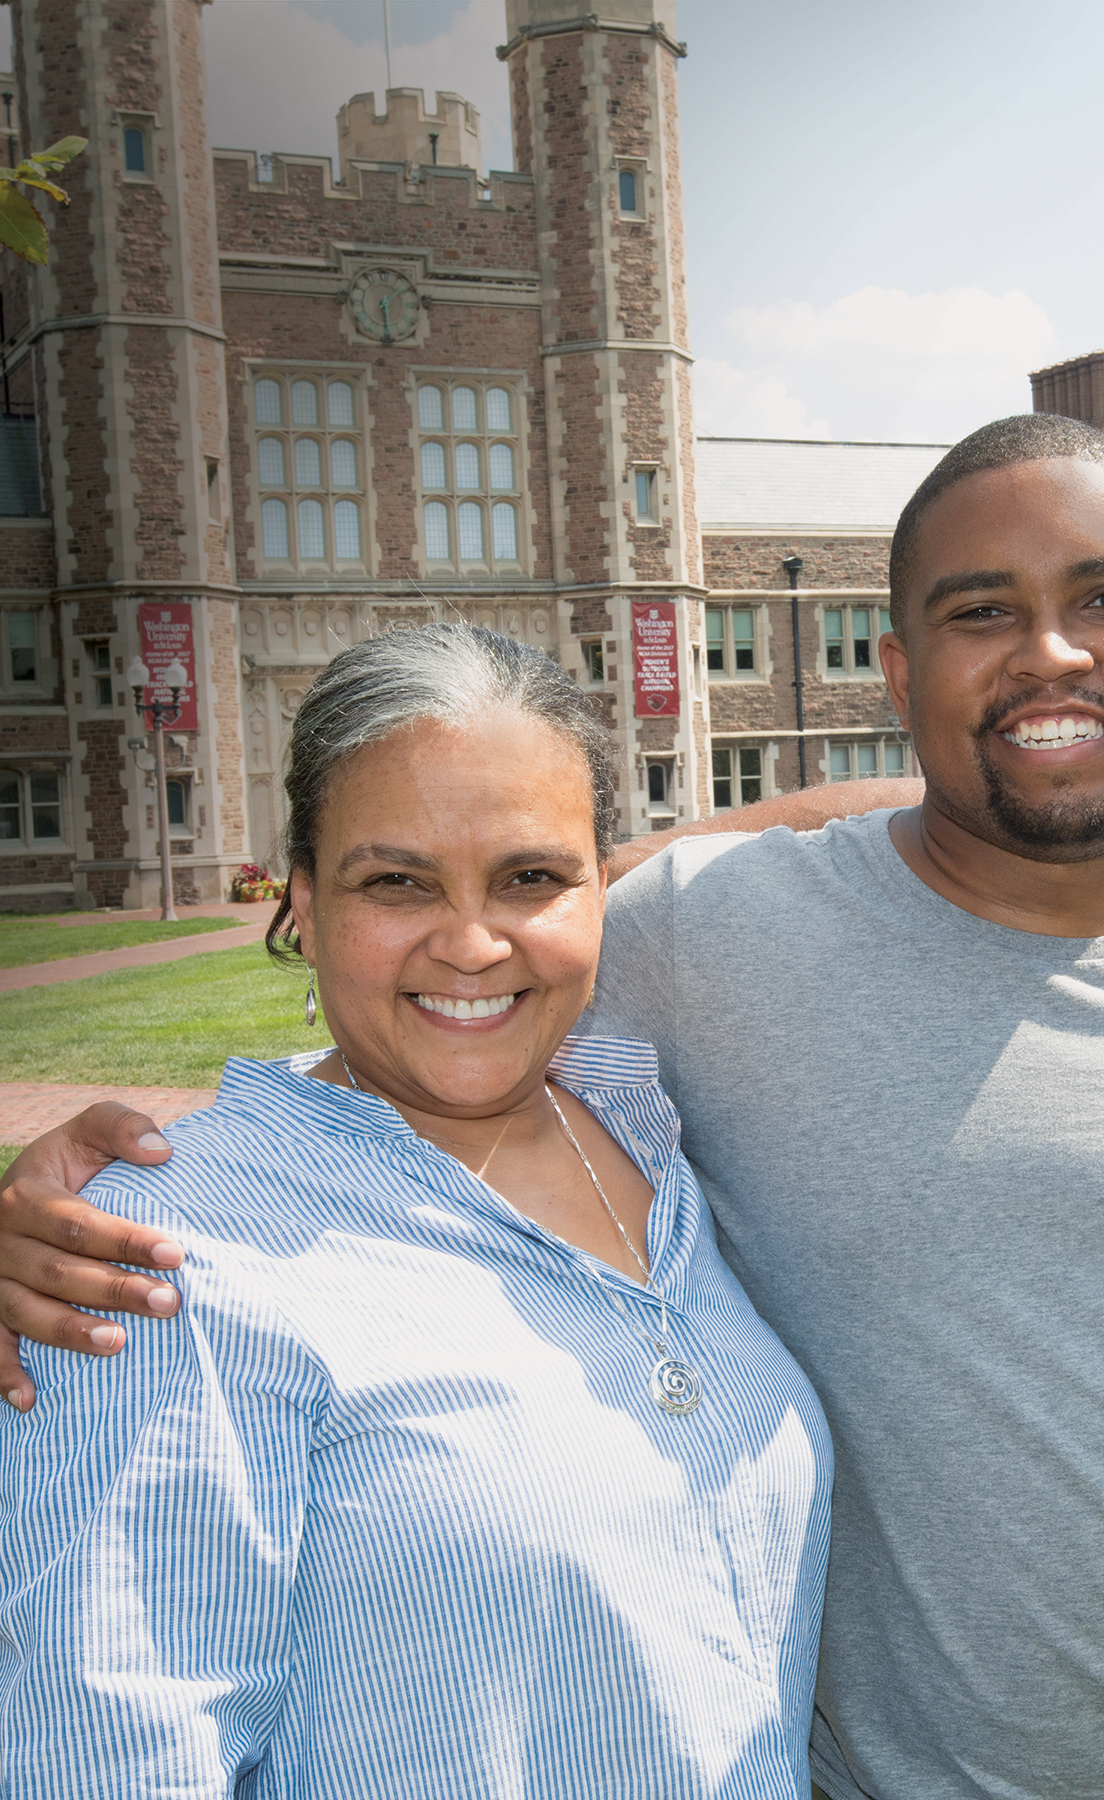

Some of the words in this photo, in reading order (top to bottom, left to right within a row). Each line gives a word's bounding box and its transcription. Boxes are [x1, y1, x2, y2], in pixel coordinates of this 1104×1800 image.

[143, 621, 190, 633] Washington
[635, 618, 674, 629] Washington
[147, 631, 187, 643] University
[638, 627, 671, 638] University
